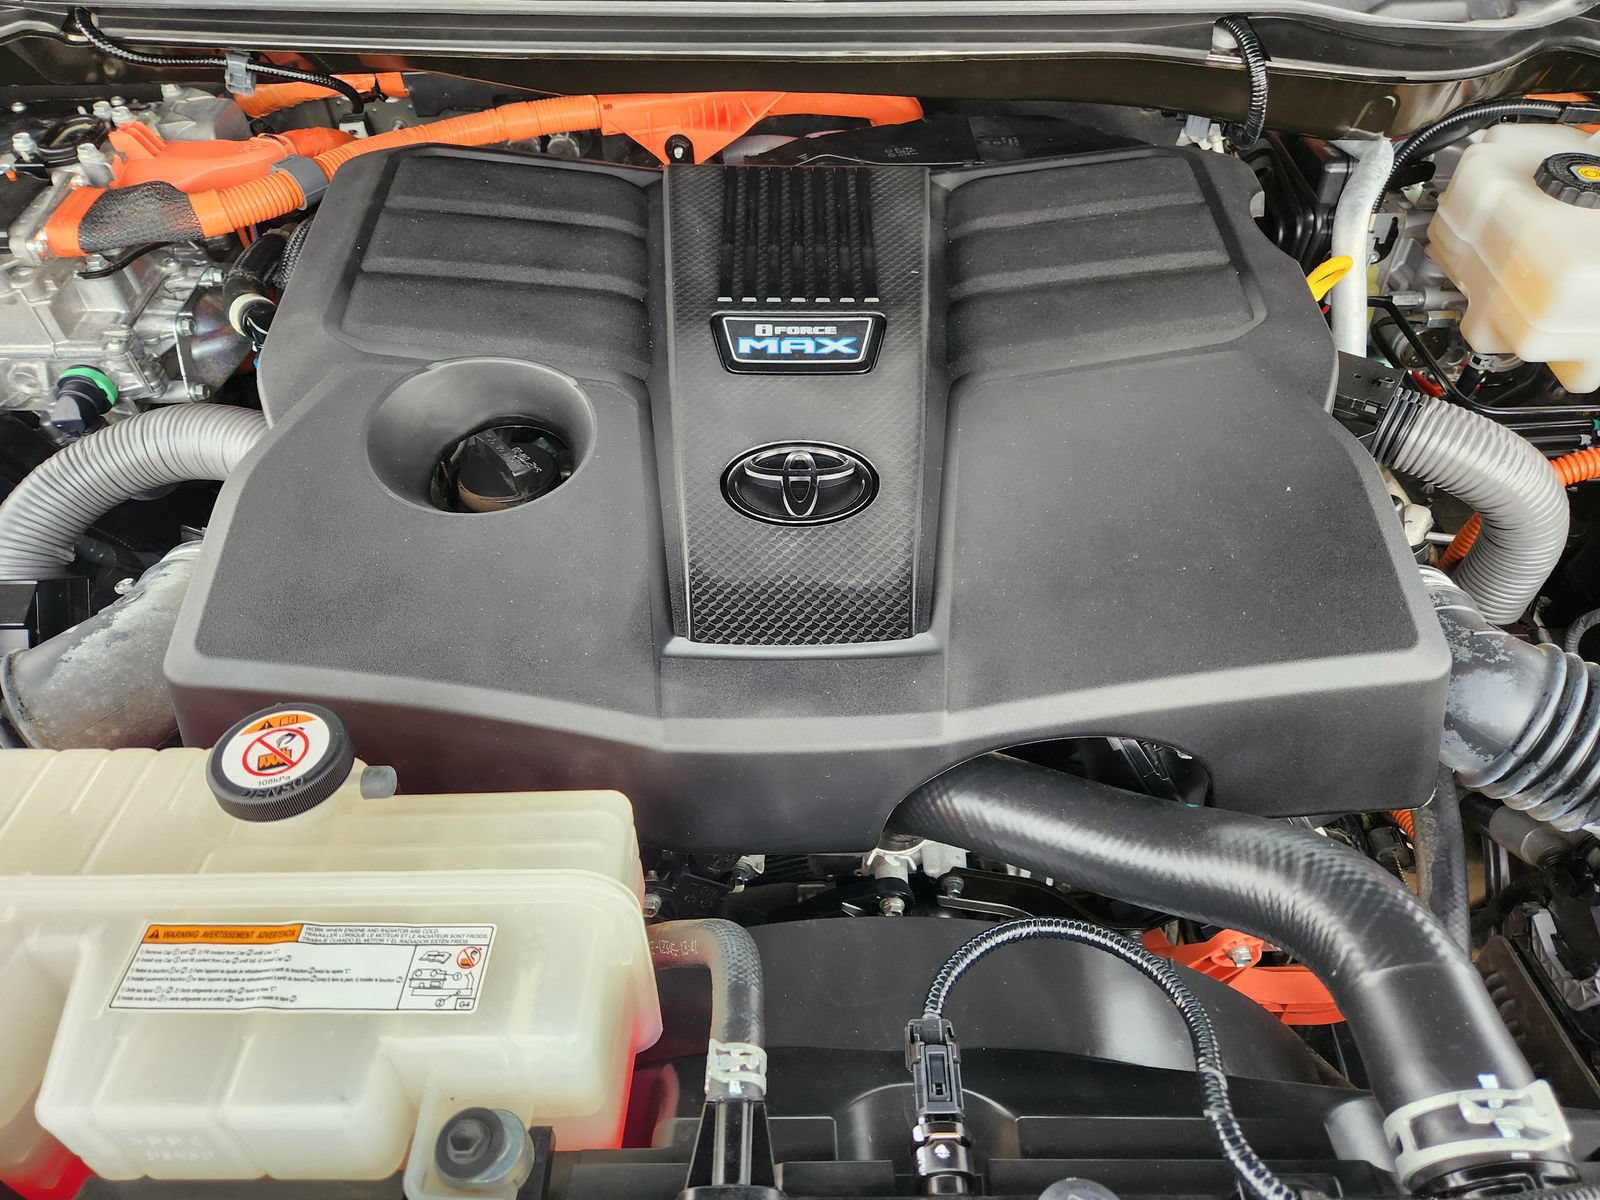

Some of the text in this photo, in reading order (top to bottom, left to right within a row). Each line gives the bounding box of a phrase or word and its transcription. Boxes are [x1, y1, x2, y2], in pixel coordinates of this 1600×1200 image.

[774, 326, 838, 335] FORCE
[737, 337, 858, 354] MAX
[162, 929, 296, 939] WARNING AVERTISSEMENT ADVERTENCIA
